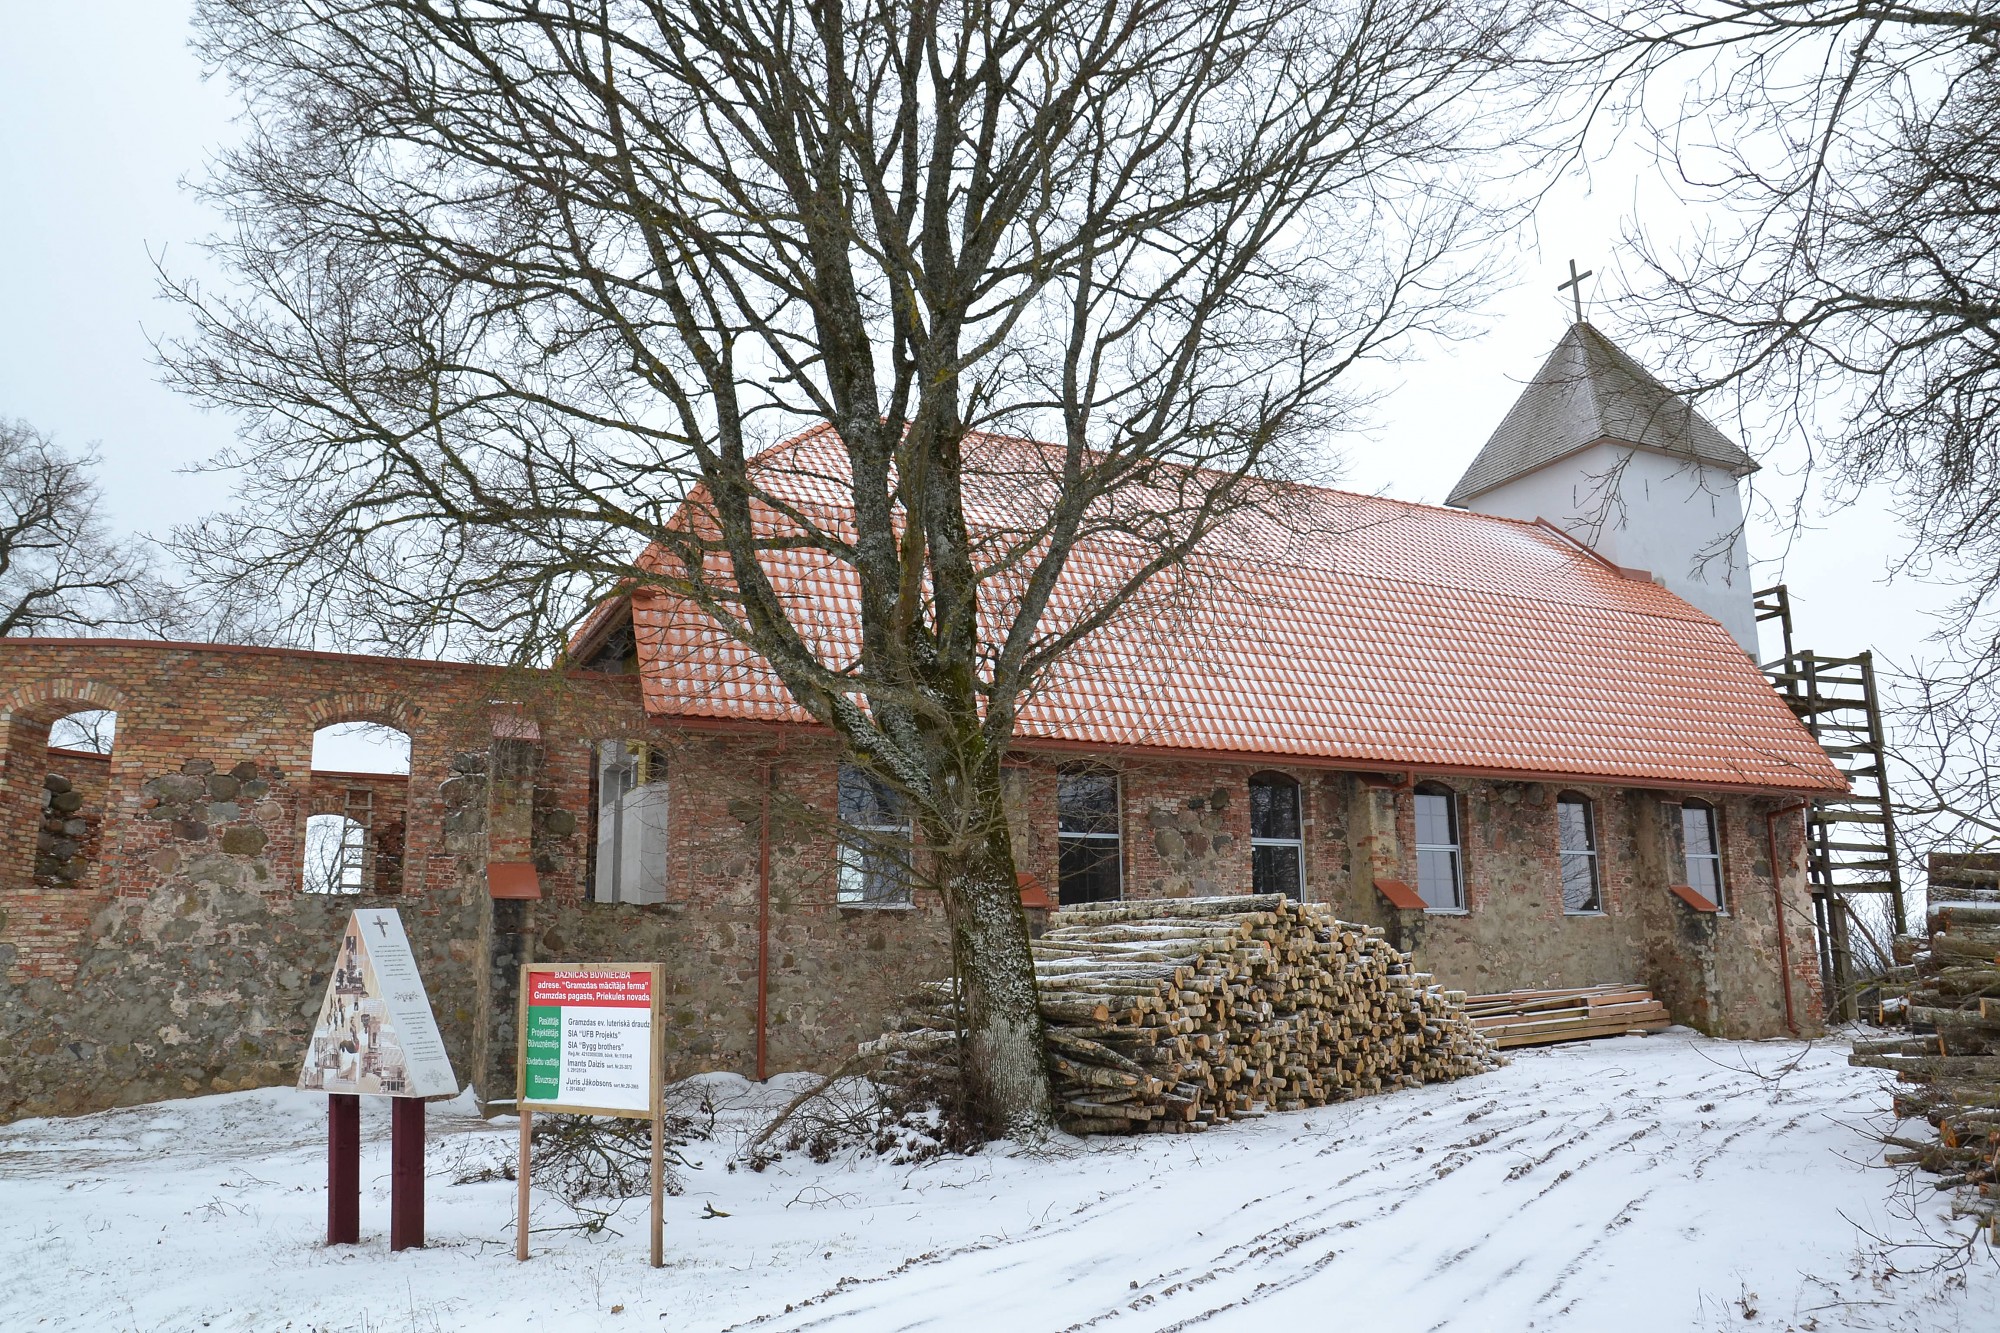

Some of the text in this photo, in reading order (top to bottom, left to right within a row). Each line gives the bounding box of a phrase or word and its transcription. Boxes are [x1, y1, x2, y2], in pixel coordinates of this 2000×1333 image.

[534, 992, 650, 1001] Gramzdas pagasts, Priekules novads.
[568, 1018, 596, 1026] Gramzdas
[607, 1019, 630, 1027] luteriskā
[568, 1059, 586, 1067] Imants
[588, 1060, 605, 1068] Daizis
[582, 1078, 612, 1087] Jākobsons
